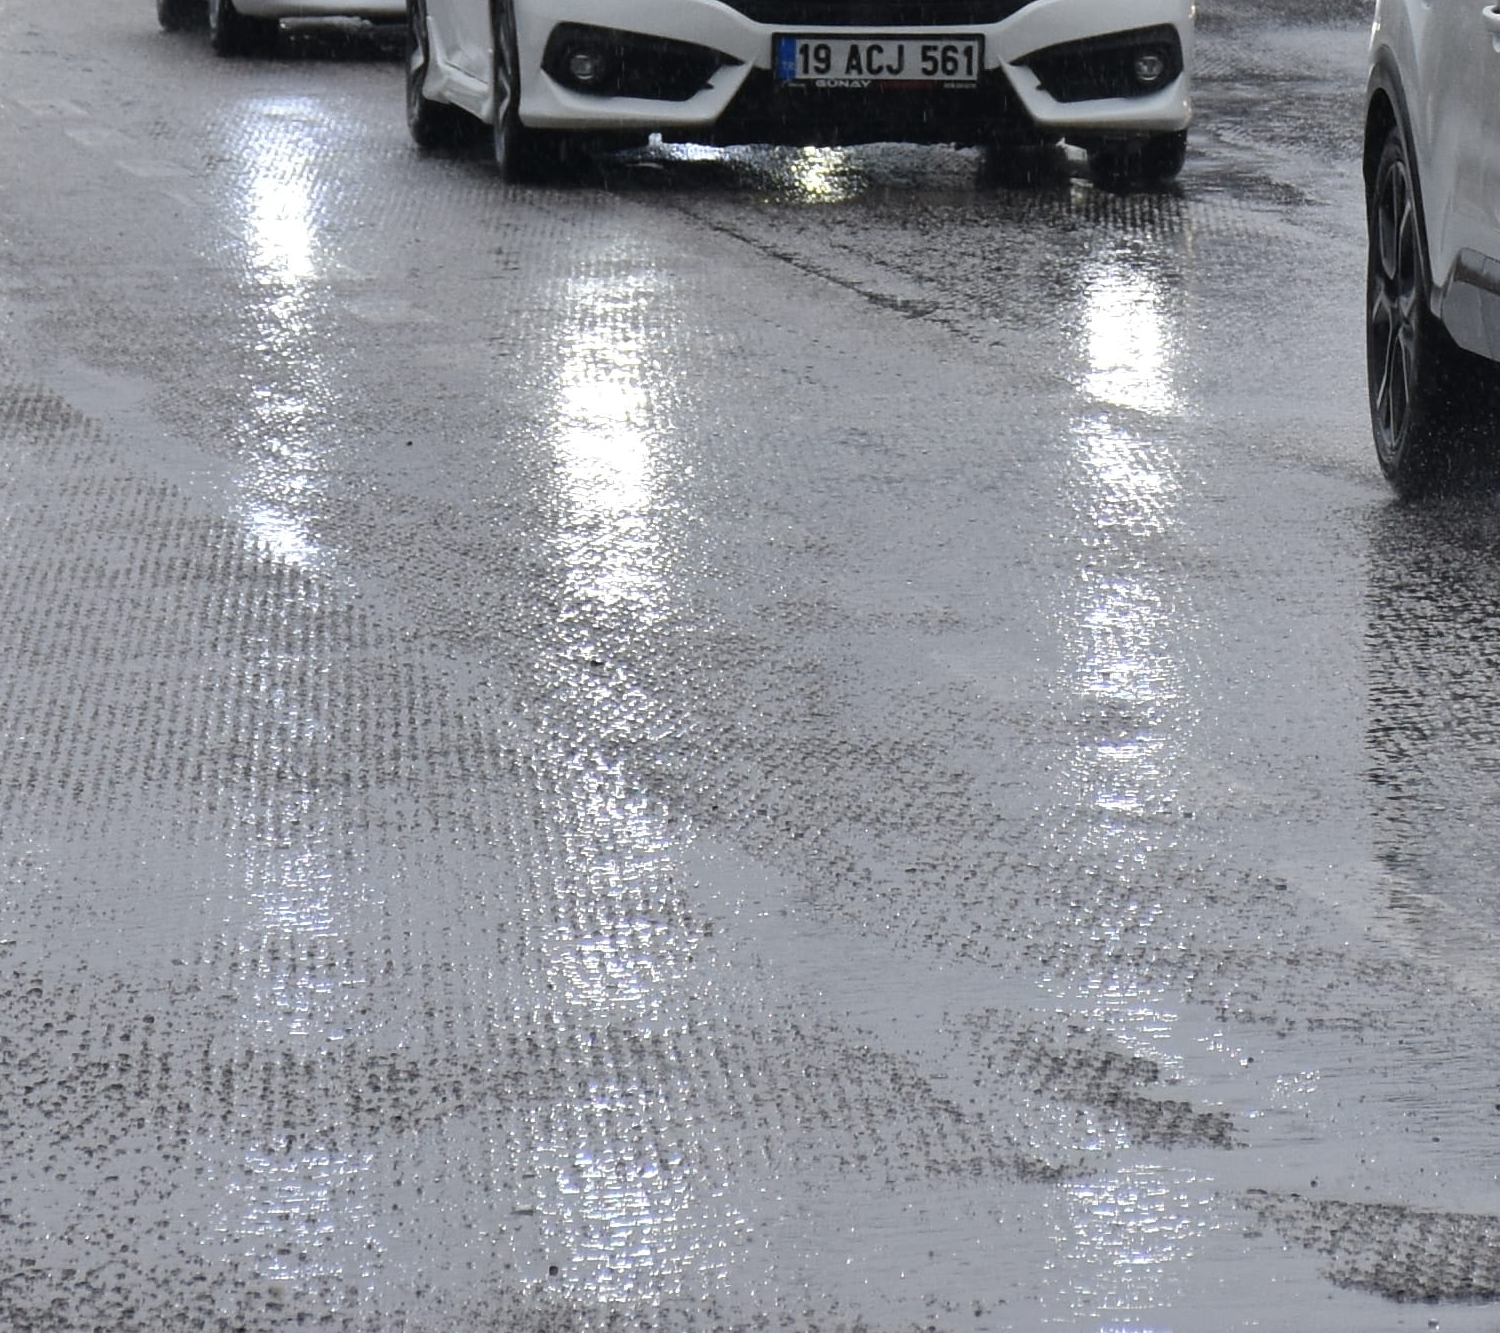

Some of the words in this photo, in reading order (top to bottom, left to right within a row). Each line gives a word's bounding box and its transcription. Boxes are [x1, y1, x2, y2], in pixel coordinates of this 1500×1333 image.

[799, 43, 831, 75] 19
[845, 44, 905, 75] ACJ
[921, 45, 974, 76] 561
